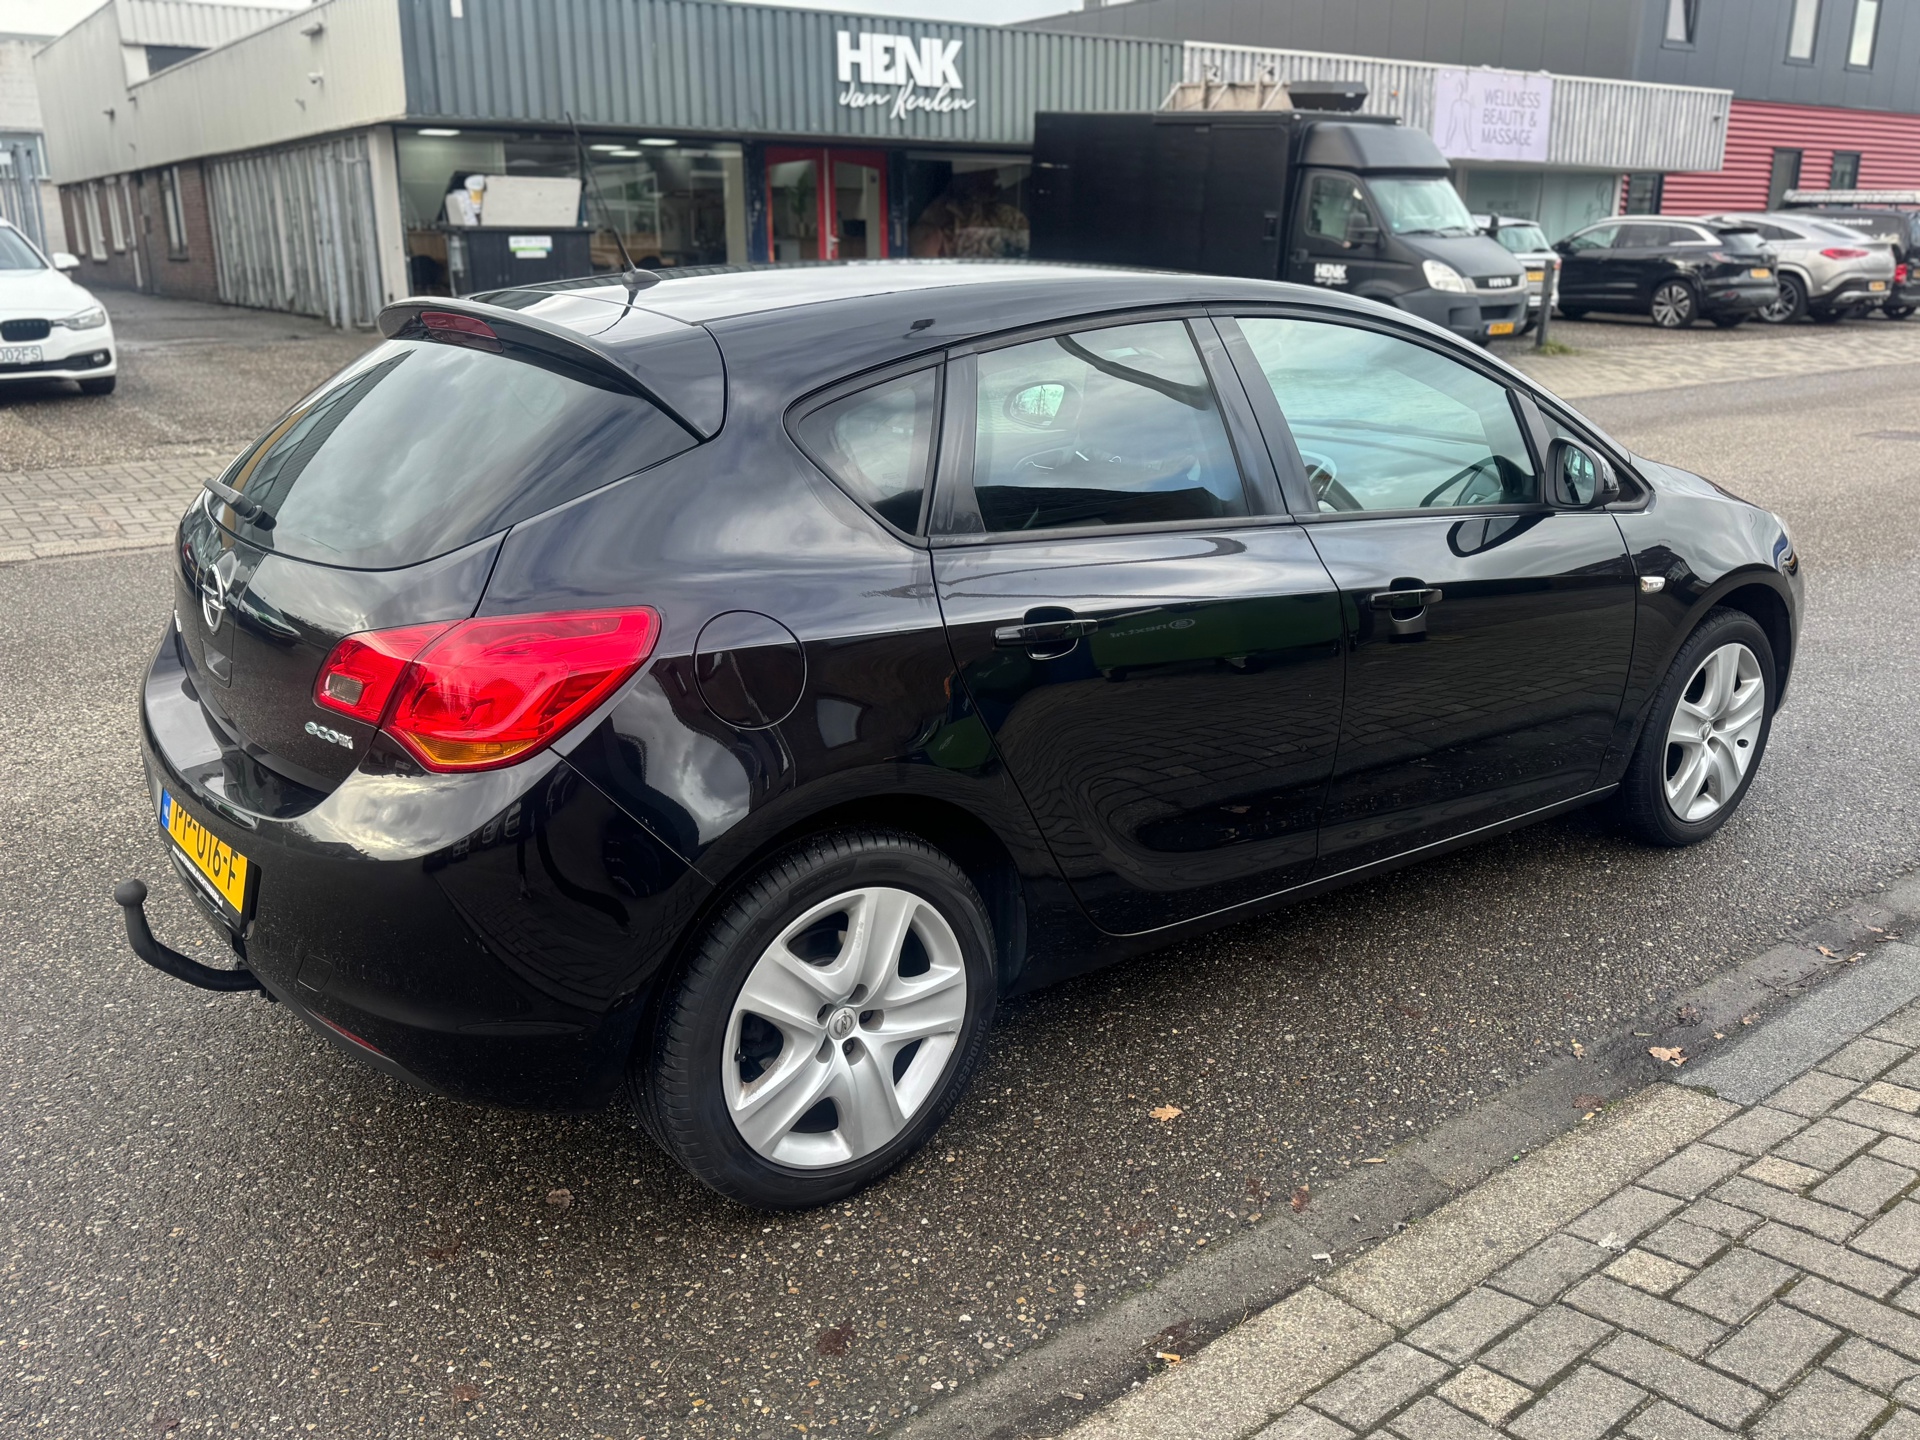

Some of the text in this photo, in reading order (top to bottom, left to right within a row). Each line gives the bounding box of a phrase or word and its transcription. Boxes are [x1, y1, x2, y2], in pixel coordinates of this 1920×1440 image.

[837, 30, 963, 89] HENK
[839, 78, 976, 120] van Keulen
[1482, 107, 1537, 128] BEAUTY &
[1484, 88, 1541, 109] WELLNESS
[1481, 127, 1532, 147] MASSAGE
[175, 804, 239, 891] PP-016-F
[936, 1017, 988, 1120] BRIDGESTONE
